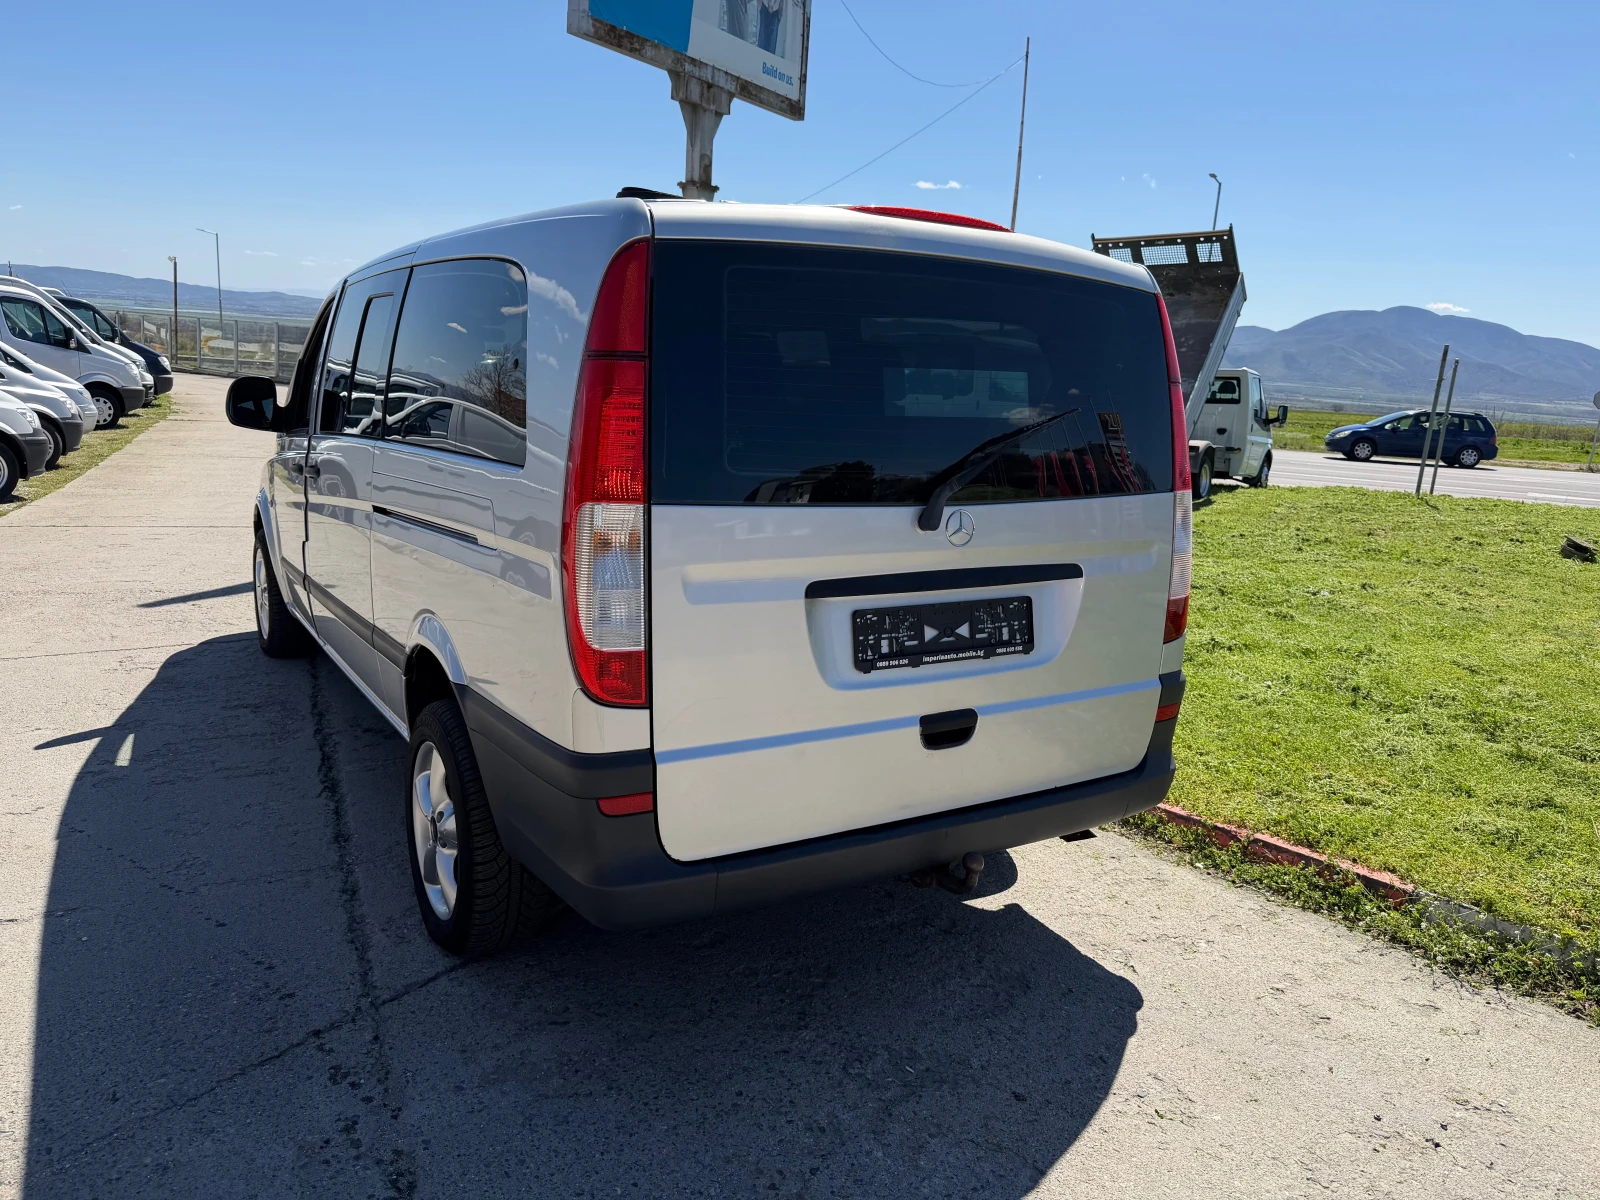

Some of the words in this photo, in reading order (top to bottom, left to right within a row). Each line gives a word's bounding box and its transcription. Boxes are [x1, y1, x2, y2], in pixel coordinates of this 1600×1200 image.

[762, 61, 778, 79] Build
[778, 71, 786, 82] on
[786, 74, 794, 87] us.
